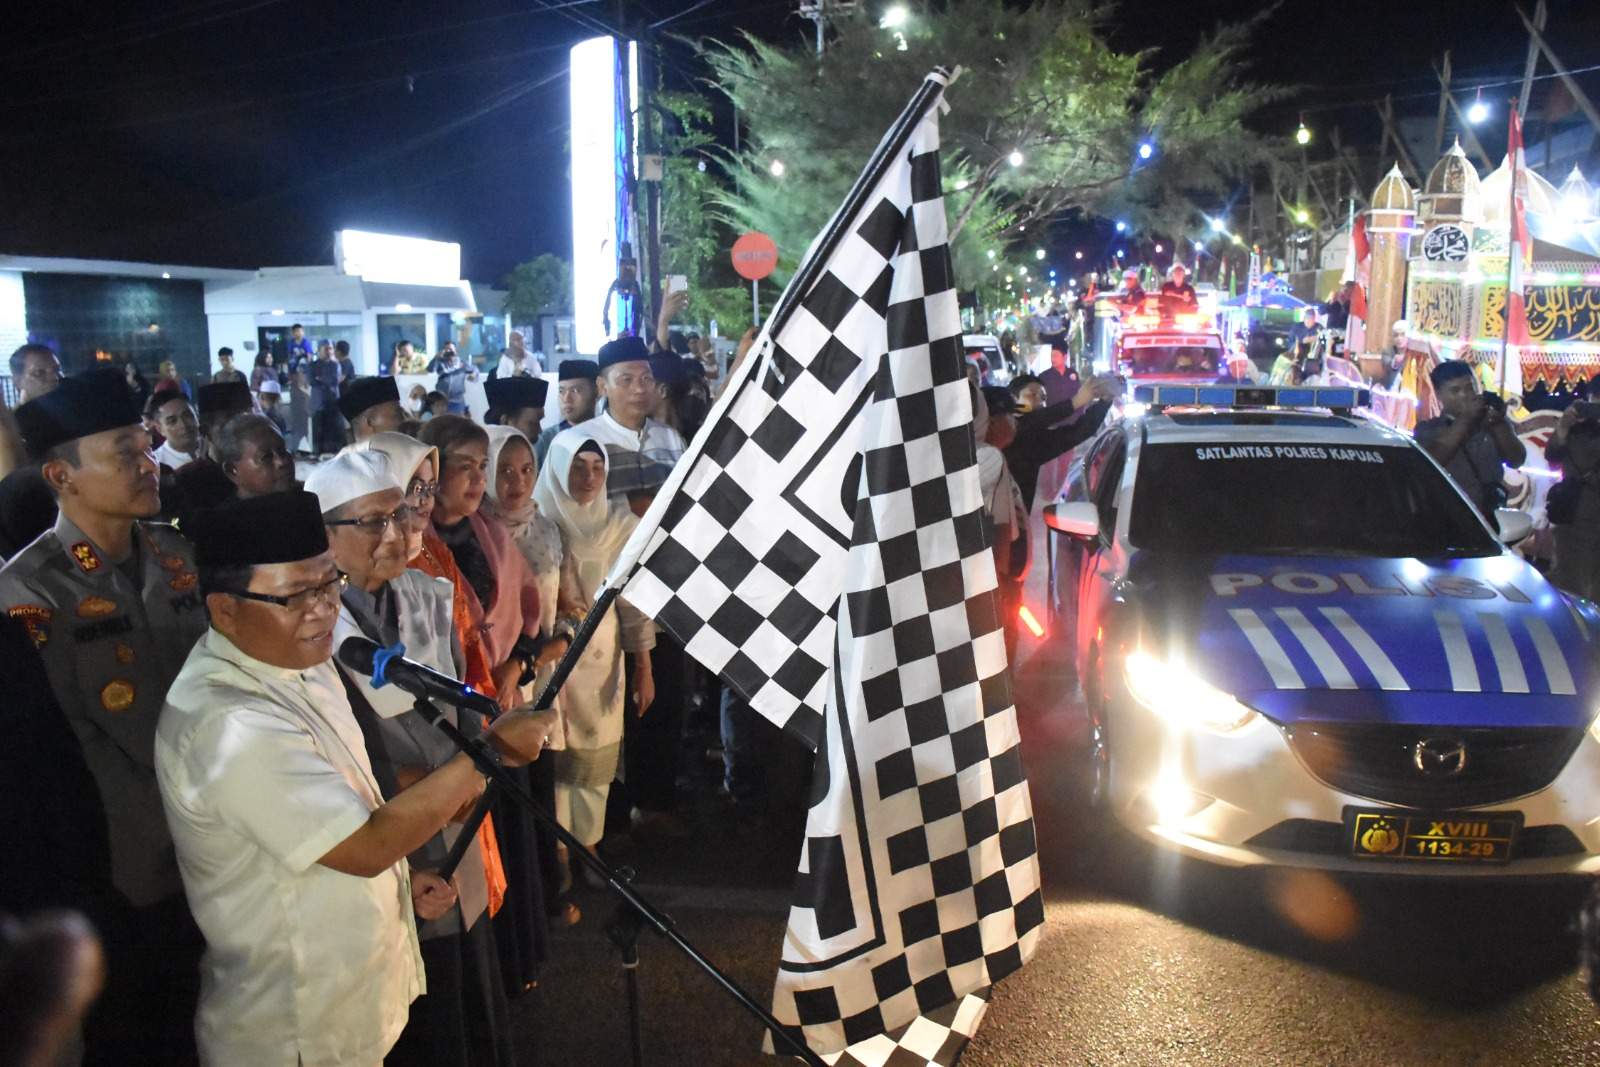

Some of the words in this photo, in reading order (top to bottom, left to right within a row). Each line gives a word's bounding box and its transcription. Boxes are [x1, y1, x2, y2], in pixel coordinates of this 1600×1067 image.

[1196, 446, 1274, 460] SATLANTAS
[1275, 446, 1328, 460] POLRES
[1329, 448, 1385, 464] KAPUAS
[1208, 572, 1533, 604] POLISI
[1427, 821, 1489, 837] XVIII
[1416, 841, 1495, 856] 1134-29
